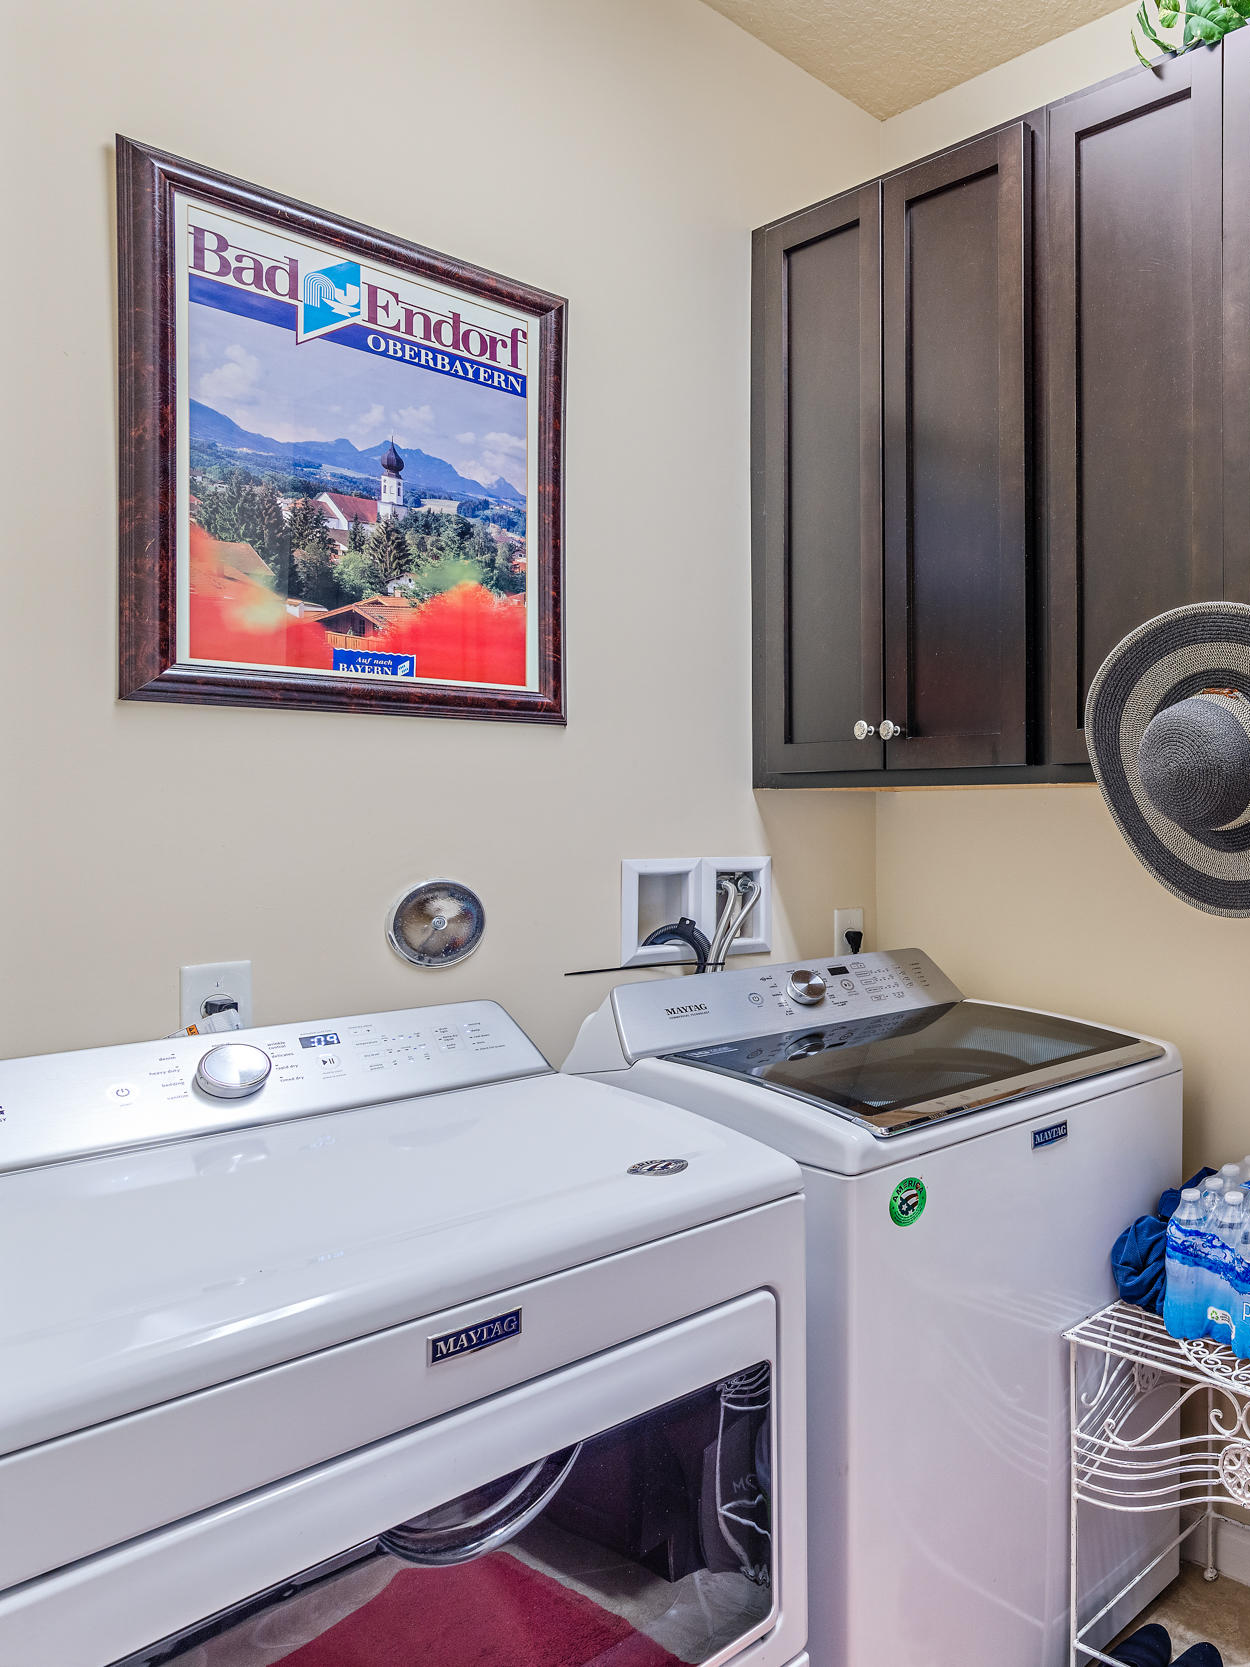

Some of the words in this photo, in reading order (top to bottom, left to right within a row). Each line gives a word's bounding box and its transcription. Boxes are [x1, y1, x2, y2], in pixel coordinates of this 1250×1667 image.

[189, 225, 299, 300] Bad
[361, 282, 527, 369] Endorf
[367, 334, 523, 393] OBERBAYERN
[339, 663, 392, 676] BAYERN
[356, 656, 373, 665] Auf
[373, 657, 393, 666] nach
[664, 1003, 708, 1016] MAYTAG
[1035, 1126, 1067, 1144] MAYTAG
[892, 1180, 924, 1203] AMERICA
[435, 1316, 518, 1358] MAYTAG
